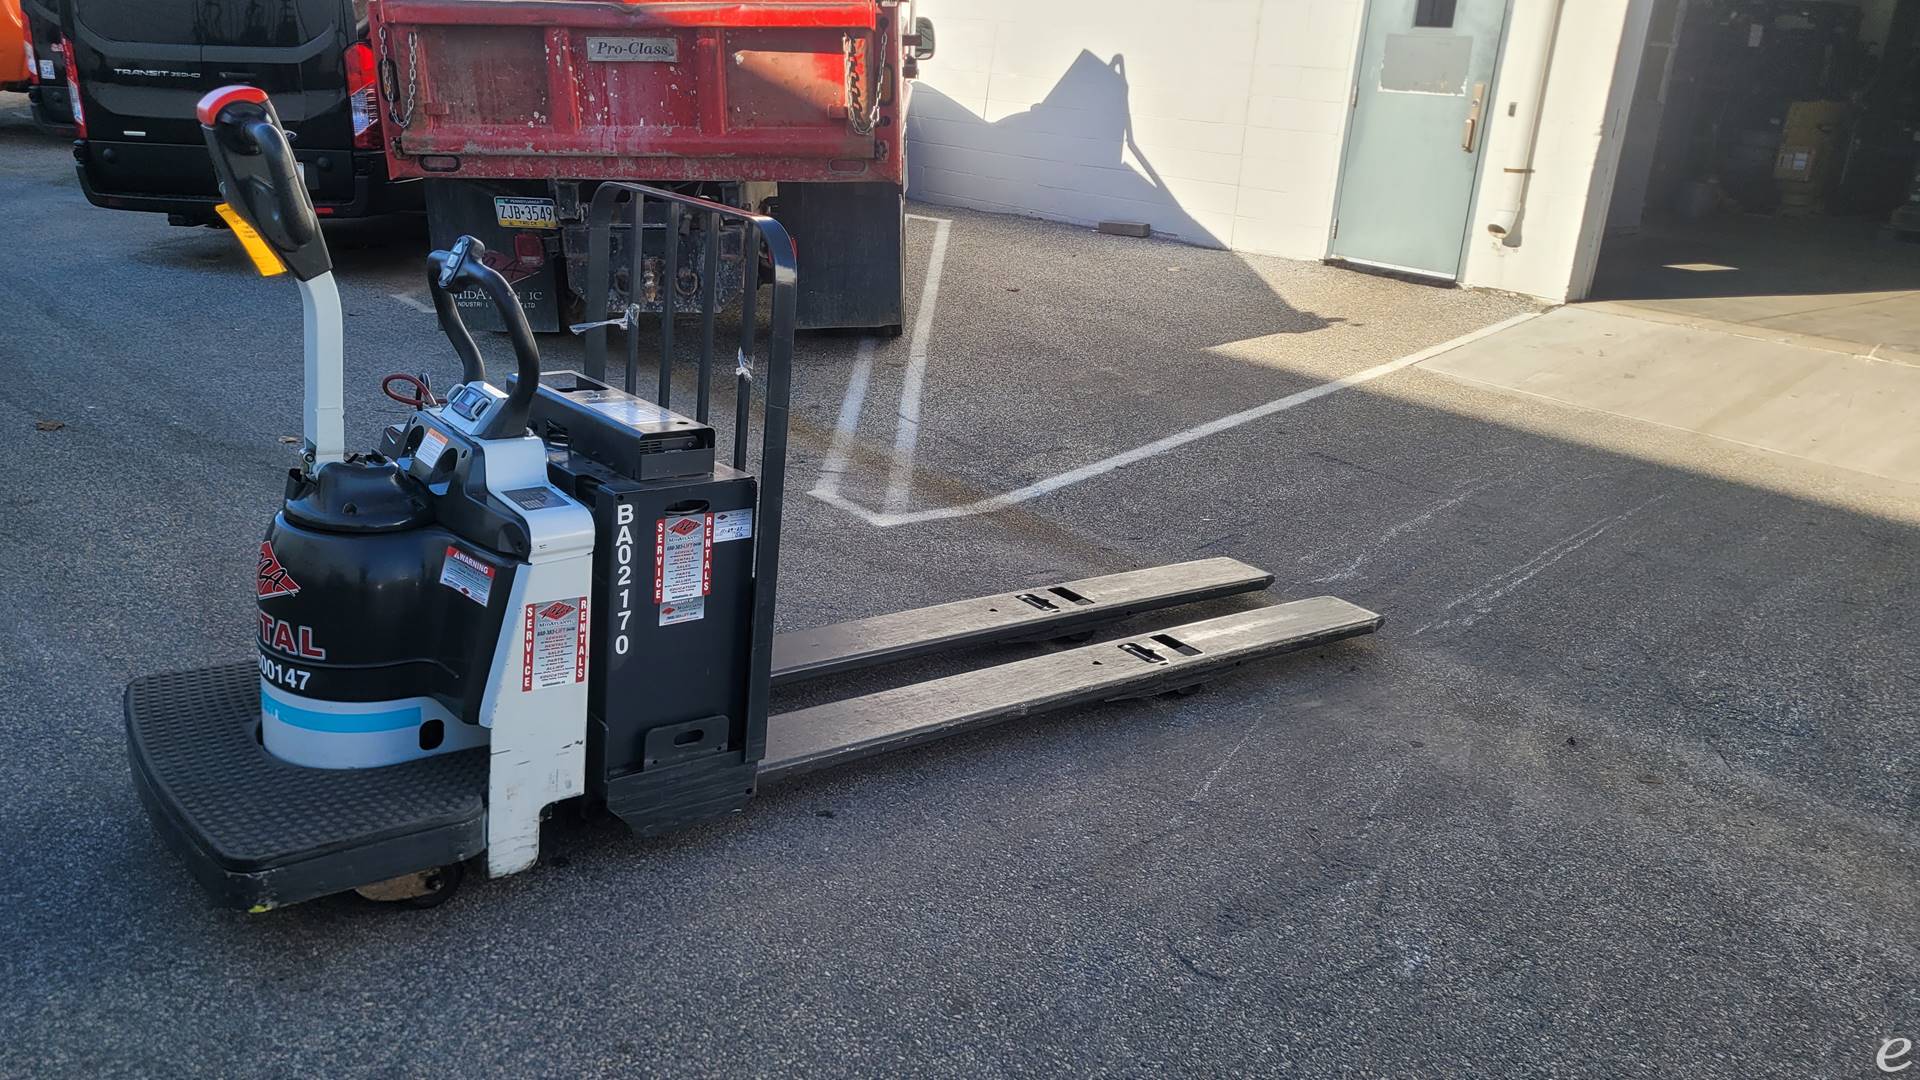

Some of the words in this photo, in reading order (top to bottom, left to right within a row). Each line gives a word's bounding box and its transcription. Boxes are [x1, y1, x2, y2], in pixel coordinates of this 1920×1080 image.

[113, 68, 169, 77] TRANSIT
[596, 41, 668, 55] Pro-Class
[459, 552, 489, 575] WARNING
[615, 503, 634, 655] BA02170
[655, 522, 664, 600] SERVICE
[703, 516, 712, 591] RENTALS
[524, 607, 533, 687] SERVICE
[577, 599, 587, 678] RENTALS
